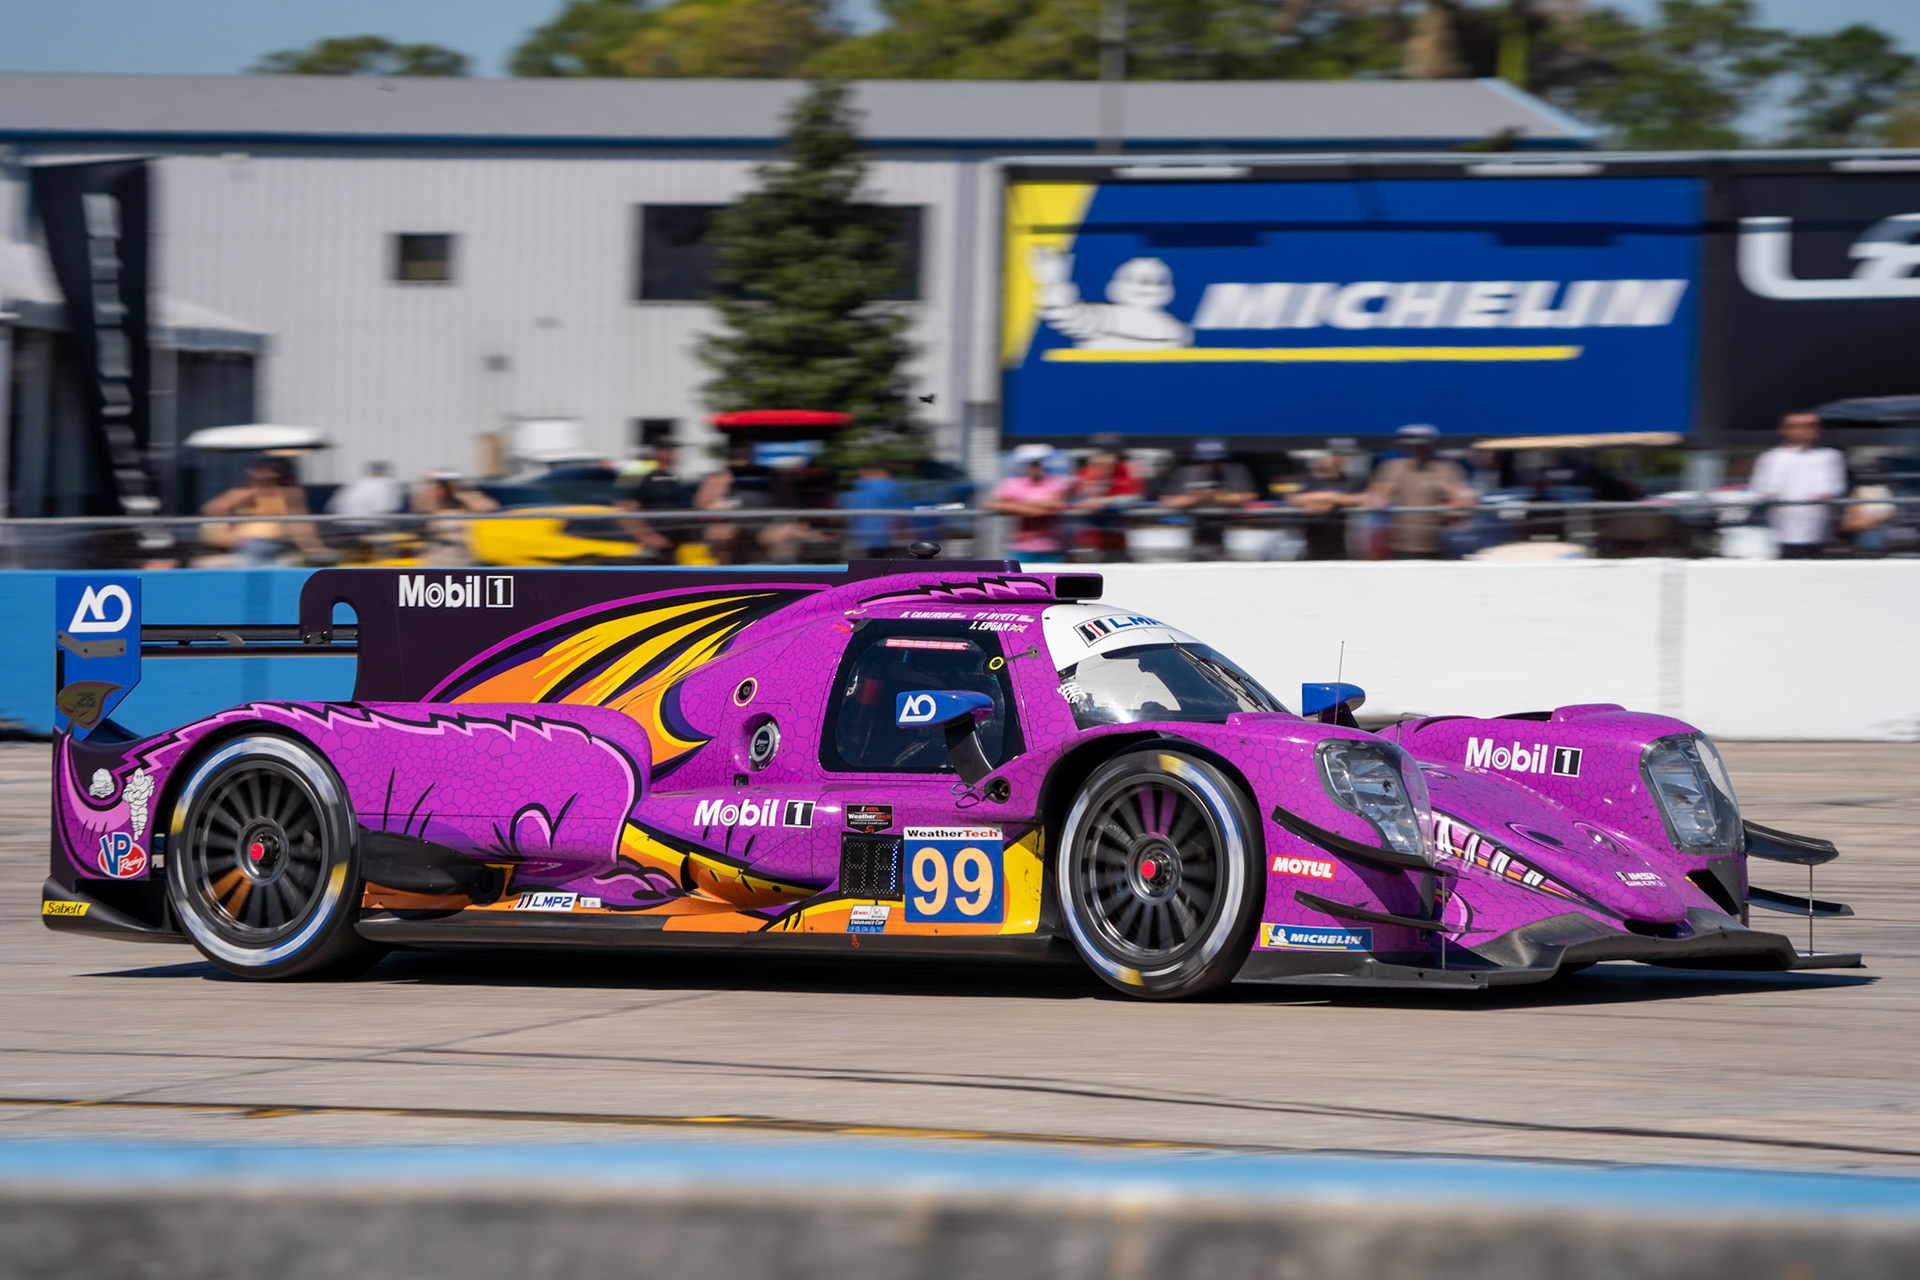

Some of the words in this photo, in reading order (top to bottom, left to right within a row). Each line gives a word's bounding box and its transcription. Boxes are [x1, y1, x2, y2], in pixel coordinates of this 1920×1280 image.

[1192, 279, 1690, 330] MICHELIN
[398, 574, 480, 608] Mobil
[977, 621, 1011, 631] EDGAR
[1464, 736, 1549, 774] Mobil
[693, 799, 780, 827] Mobil
[906, 828, 999, 839] WeatherTech
[100, 832, 132, 876] VP
[120, 856, 146, 872] Racing
[1272, 857, 1333, 878] MOTUL
[911, 847, 994, 916] 99
[47, 902, 82, 914] Sabelt
[532, 896, 573, 907] LMP2
[1289, 933, 1363, 945] MICHELIN
